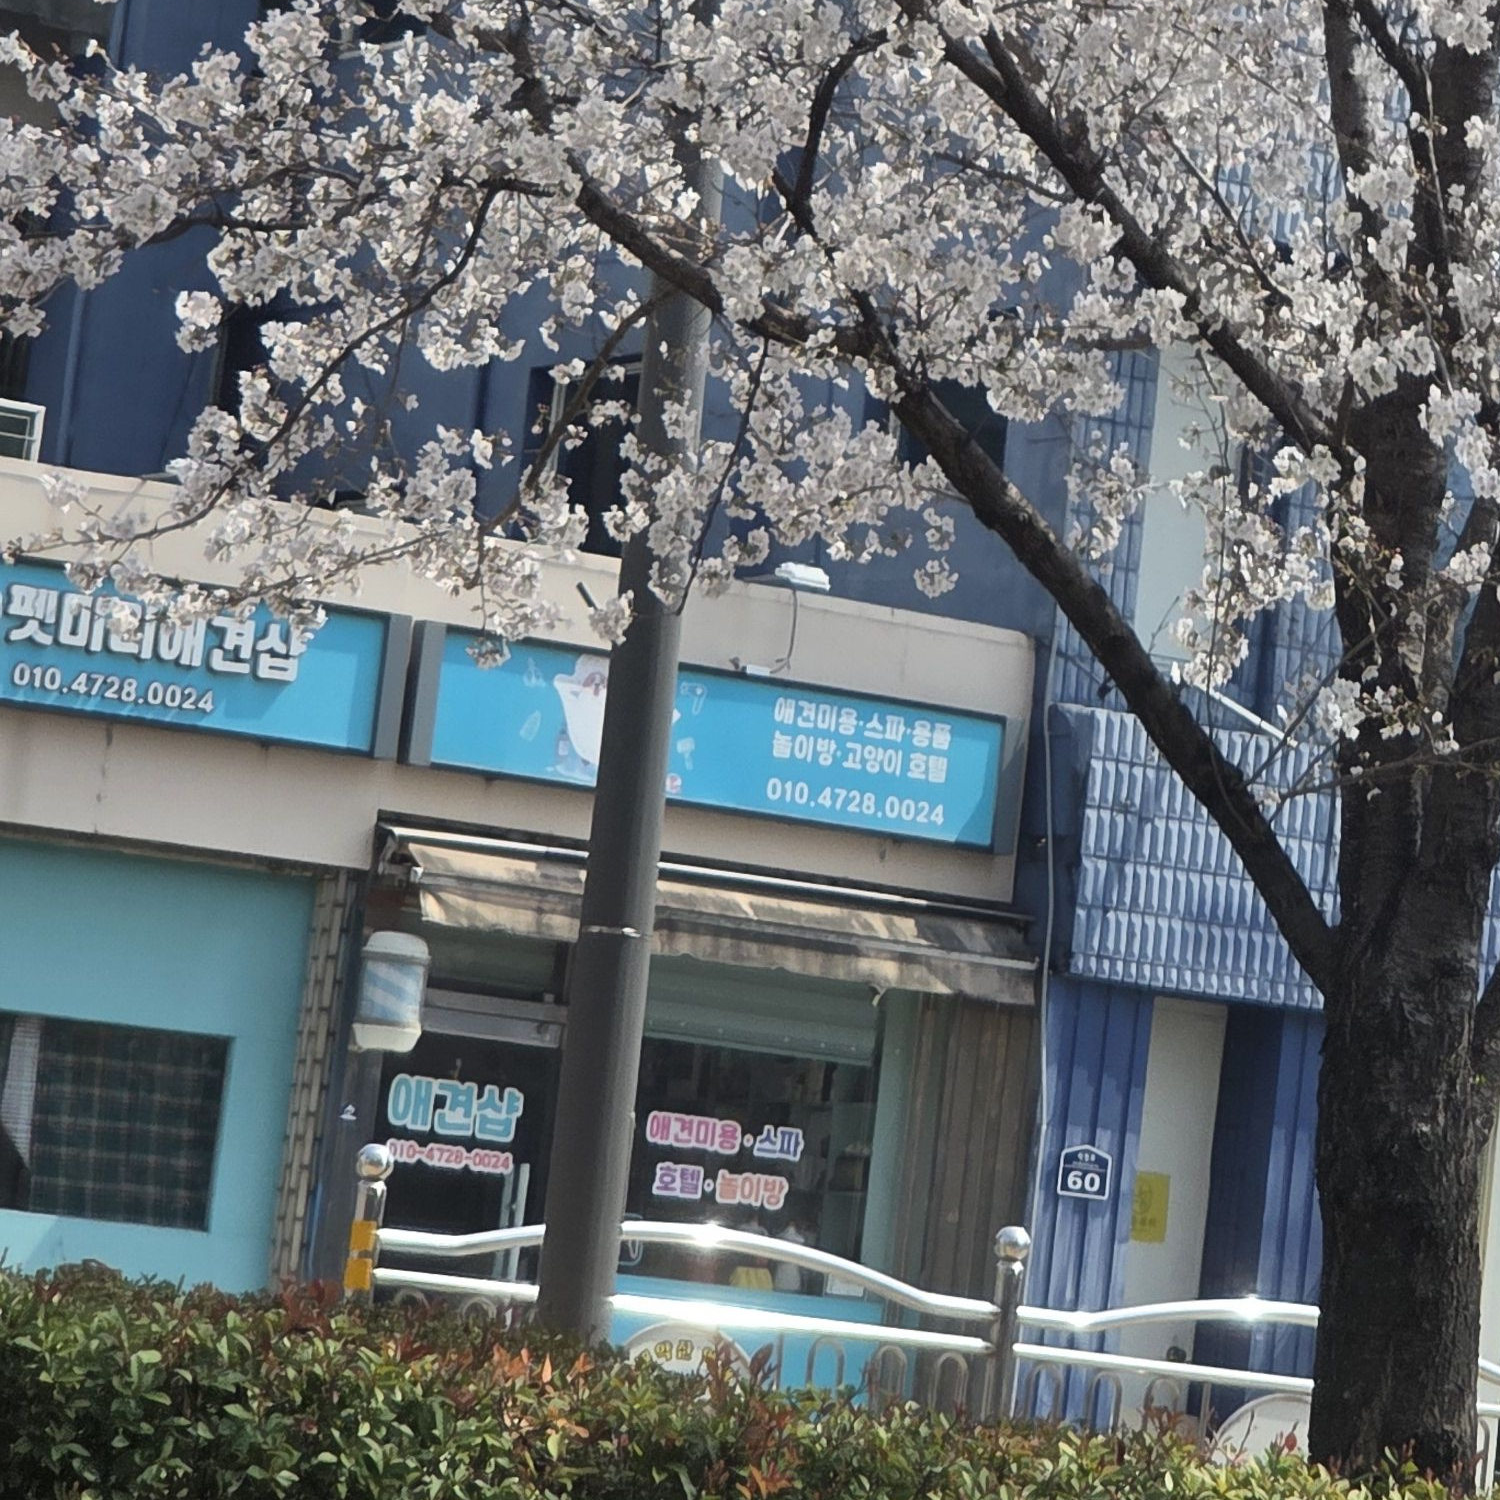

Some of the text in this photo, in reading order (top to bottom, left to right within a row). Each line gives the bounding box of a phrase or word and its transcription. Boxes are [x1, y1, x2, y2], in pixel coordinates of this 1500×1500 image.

[13, 663, 215, 712] 010.4728.0024
[907, 752, 948, 784] 호텔
[766, 777, 945, 826] 010.4728.0024
[389, 1074, 524, 1142] 애견샵
[1067, 1171, 1100, 1192] 60
